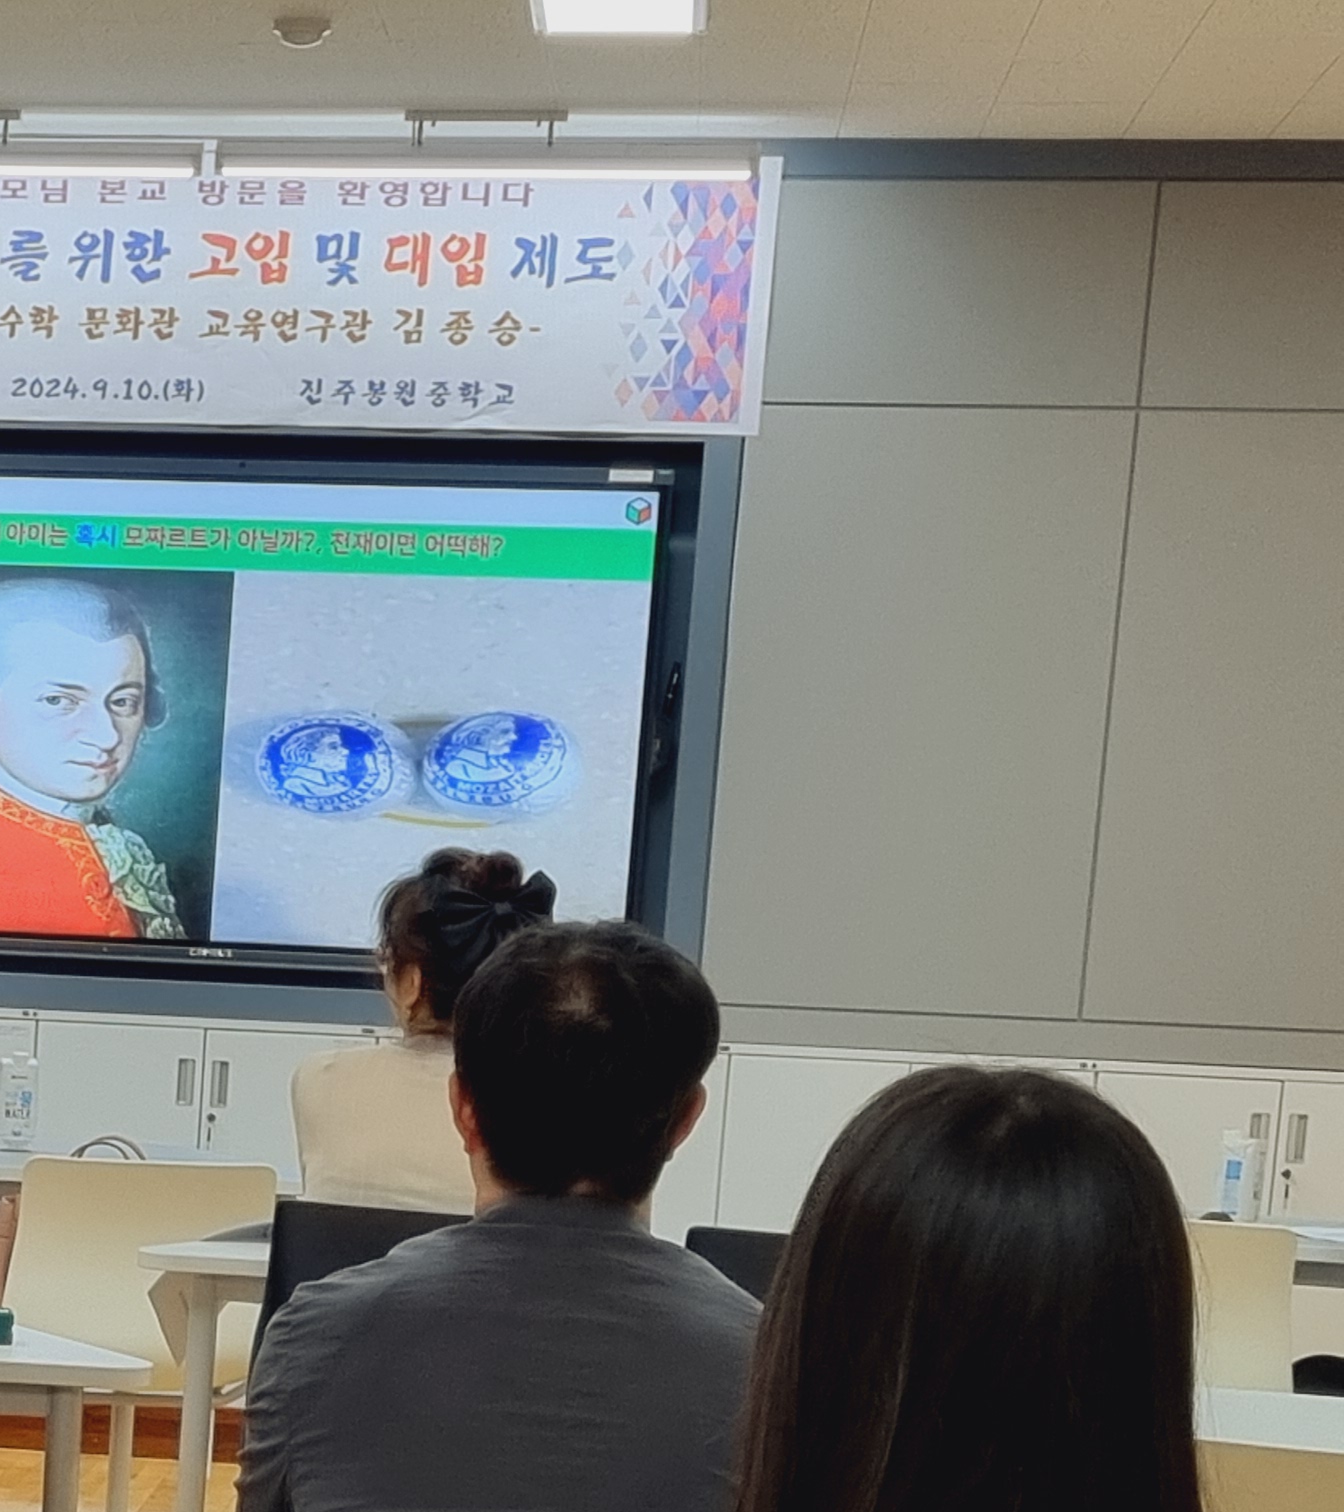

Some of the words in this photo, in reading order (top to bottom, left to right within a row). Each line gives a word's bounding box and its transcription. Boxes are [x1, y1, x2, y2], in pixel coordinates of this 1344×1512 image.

[97, 179, 167, 204] 본교
[197, 179, 308, 206] 방문을
[337, 180, 535, 208] 환영합니다
[68, 228, 172, 284] 위한
[187, 229, 292, 287] 고입
[315, 230, 362, 287] 및
[382, 231, 489, 288] 대입
[510, 231, 619, 289] 제도
[78, 305, 181, 341] 문화관
[198, 308, 373, 344] 교육연구관
[10, 375, 205, 402] 2024.9.10.(화)
[5, 522, 69, 548] 아이는
[122, 525, 232, 551] 모짜르트가
